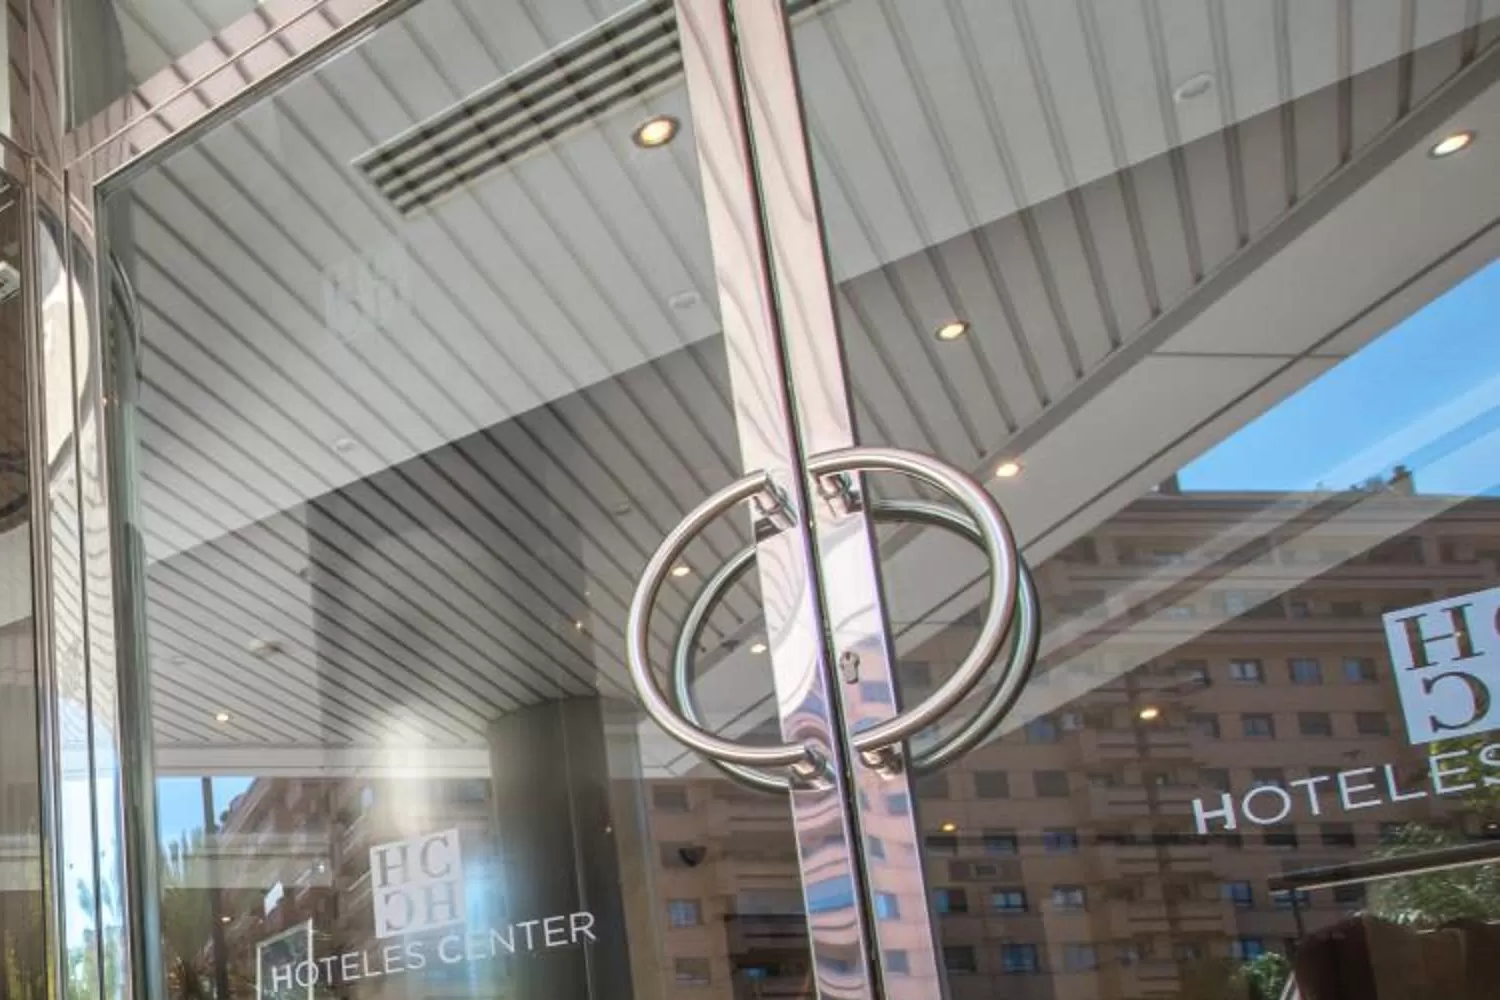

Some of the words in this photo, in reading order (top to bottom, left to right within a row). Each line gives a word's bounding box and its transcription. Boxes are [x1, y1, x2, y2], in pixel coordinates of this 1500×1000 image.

[1192, 743, 1500, 835] HOTELES
[271, 940, 426, 993] HOTELES
[438, 911, 597, 965] CENTER
